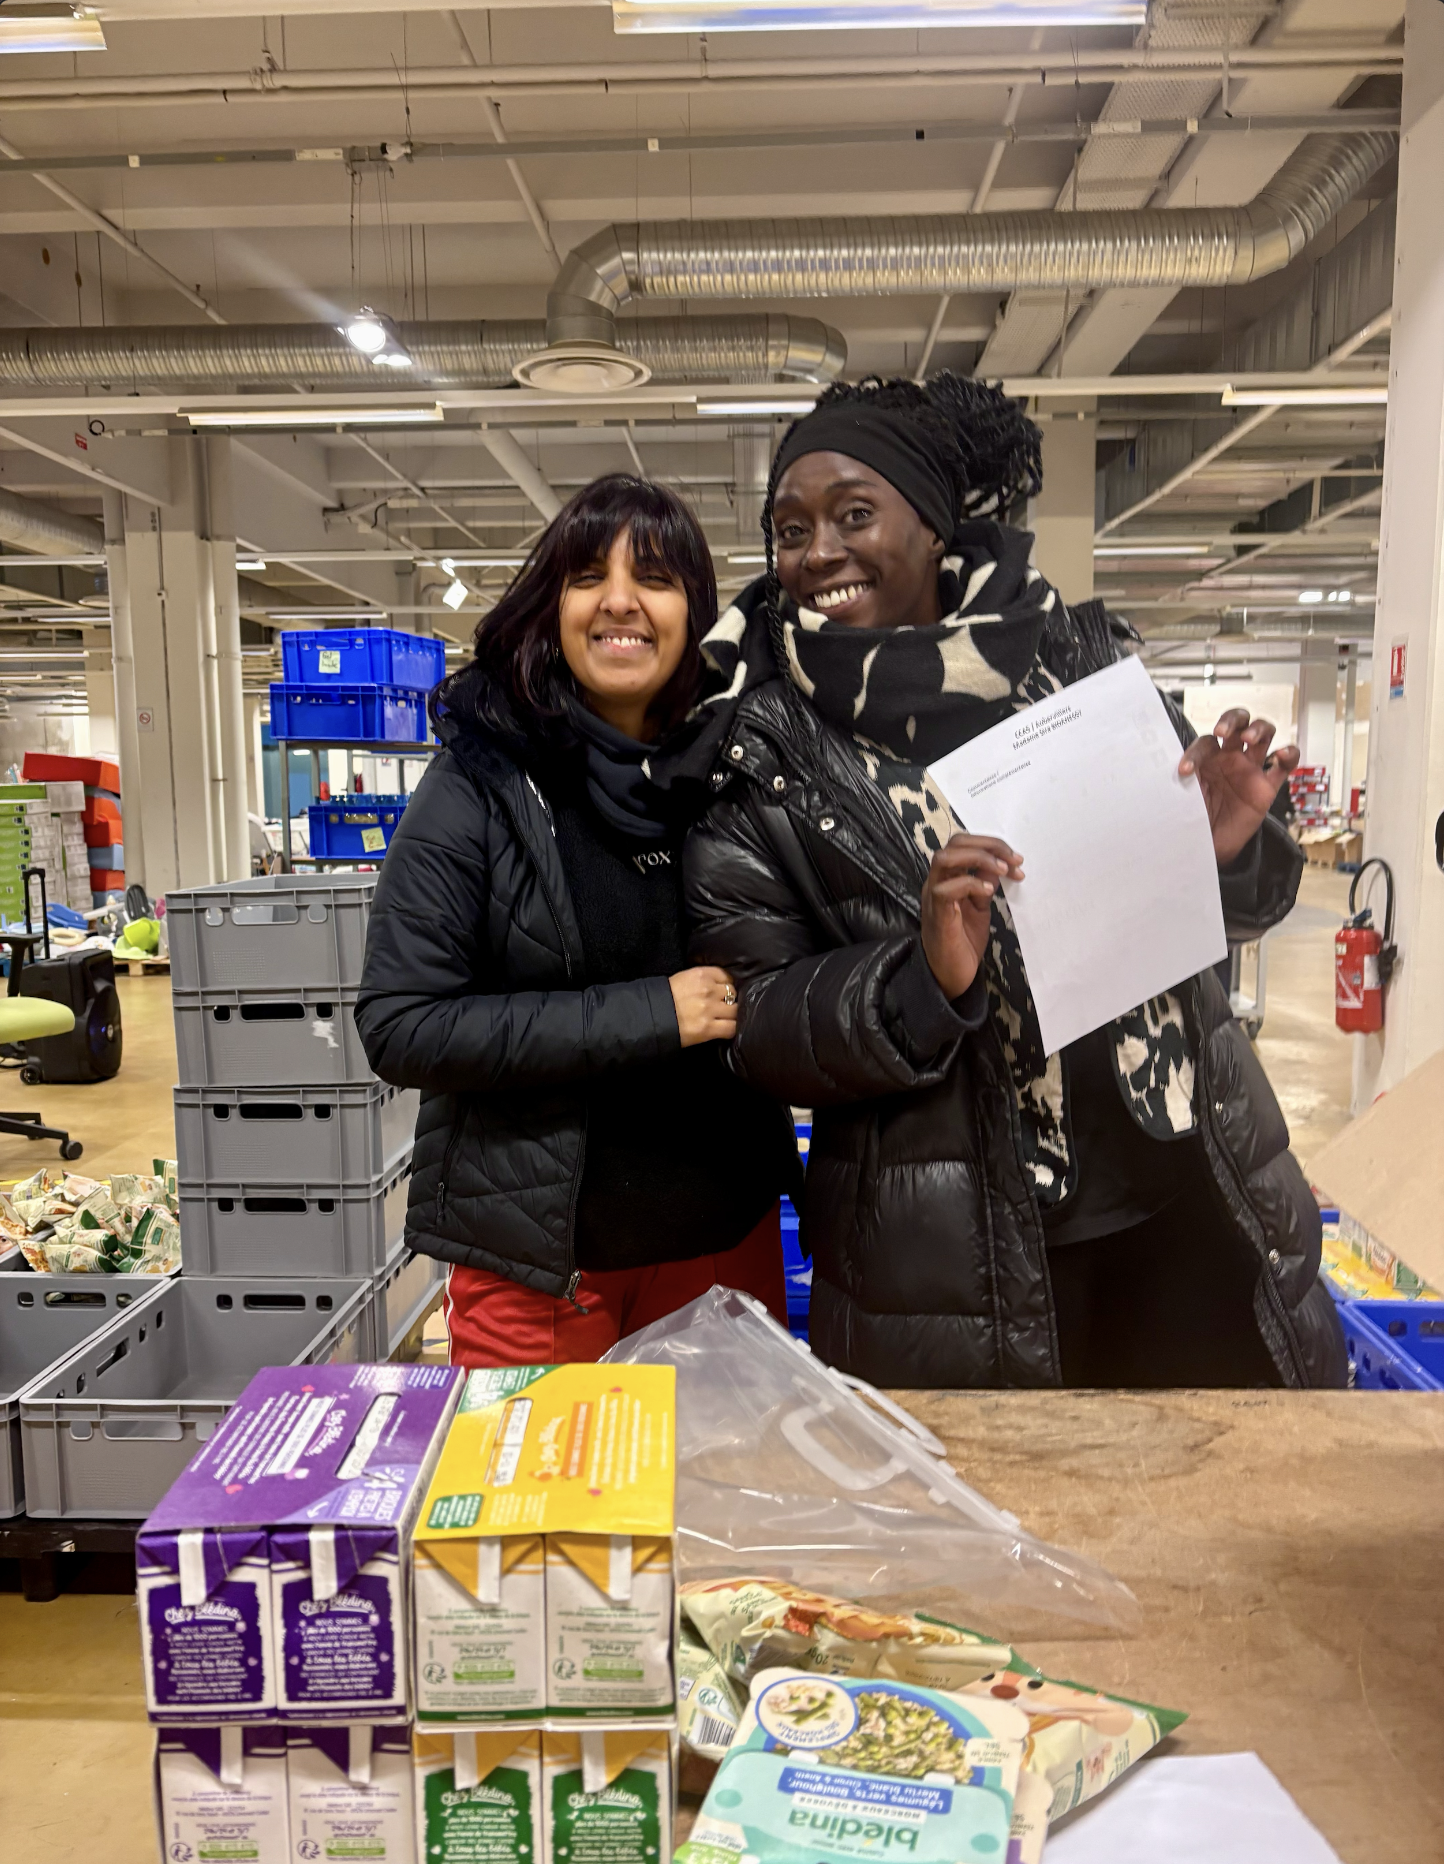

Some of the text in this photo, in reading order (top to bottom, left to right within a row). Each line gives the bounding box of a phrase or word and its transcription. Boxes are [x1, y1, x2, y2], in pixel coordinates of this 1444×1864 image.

[904, 1785, 940, 1799] Merlu
[890, 1794, 944, 1810] Légumes
[788, 1809, 920, 1853] blédina
